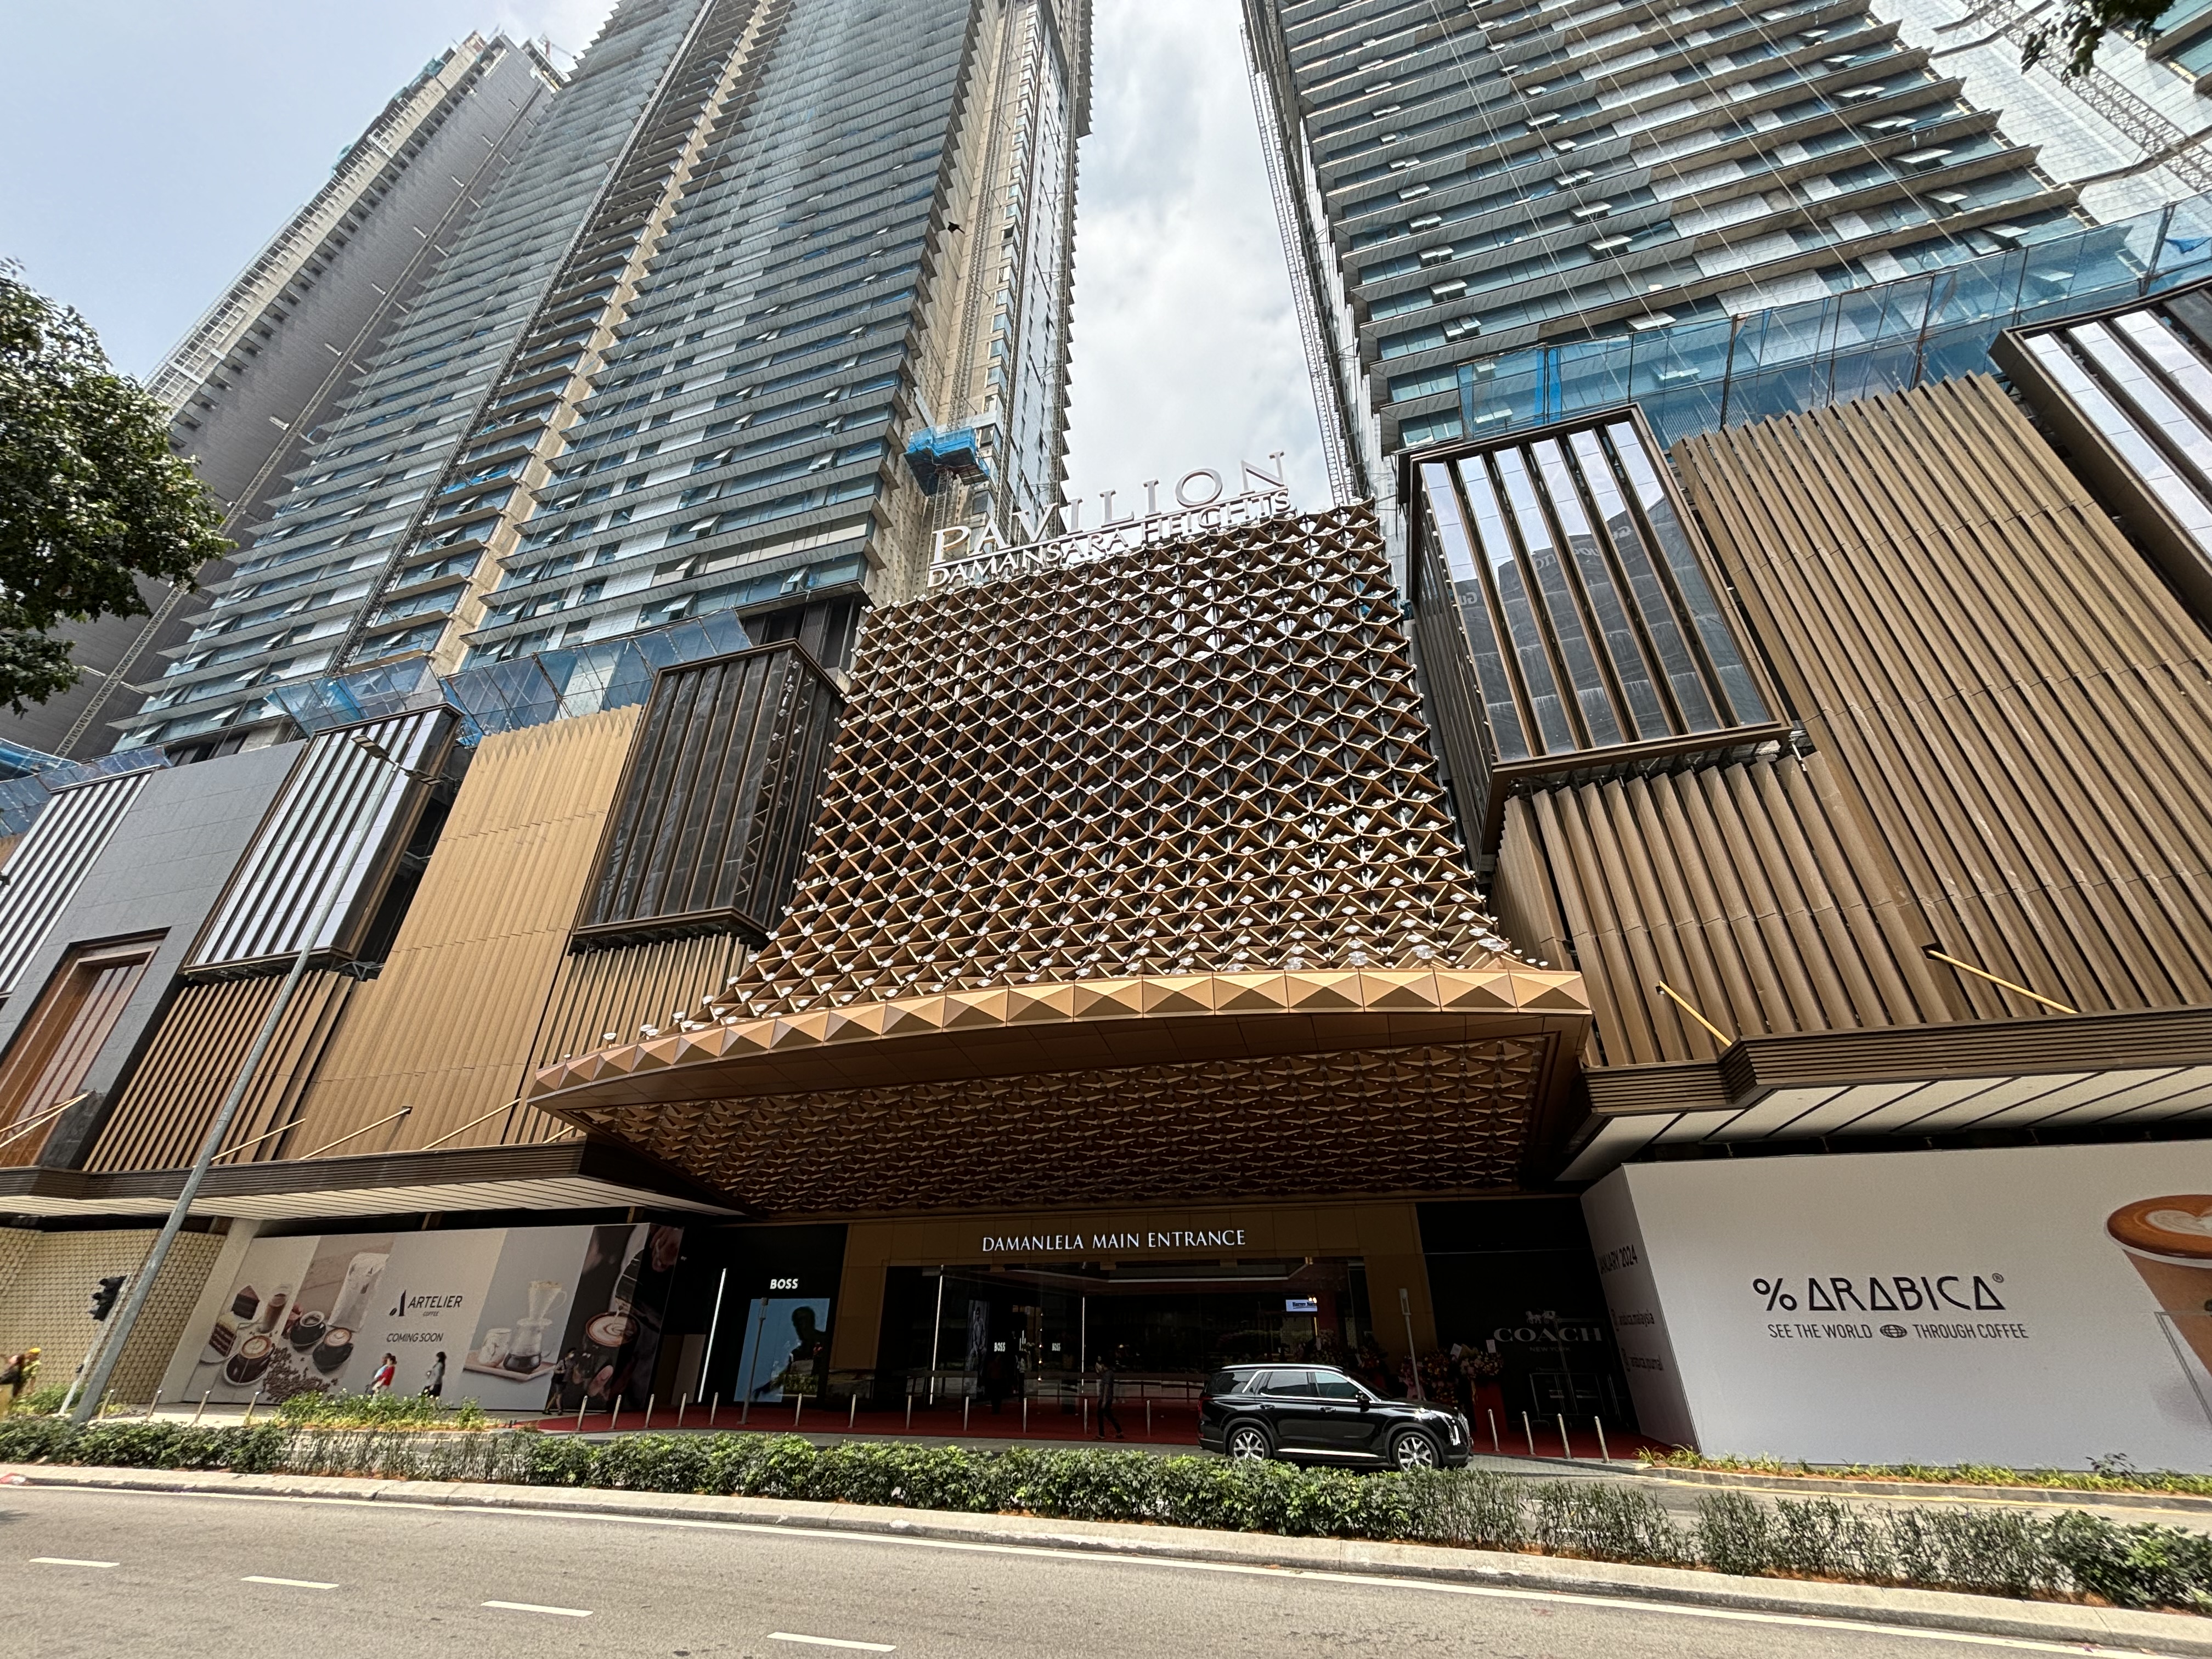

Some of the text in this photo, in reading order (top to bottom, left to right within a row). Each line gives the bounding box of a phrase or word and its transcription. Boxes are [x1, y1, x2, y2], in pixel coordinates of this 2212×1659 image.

[931, 450, 1285, 565] PAVILION
[927, 489, 1291, 588] DAMANSARA HEIGHTS
[982, 1229, 1246, 1252] DAMANLELA MAIN ENTRANCE
[1619, 1244, 1638, 1268] 2024
[770, 1278, 798, 1289] BOSS
[408, 1295, 463, 1308] ARTELIER
[1753, 1278, 1797, 1311] %
[386, 1333, 444, 1342] COMING SOON
[1493, 1327, 1602, 1342] COACH
[1768, 1323, 2029, 1339] SEE THE WORLD THROUGH COFFEE
[994, 1342, 1006, 1352] BOSS
